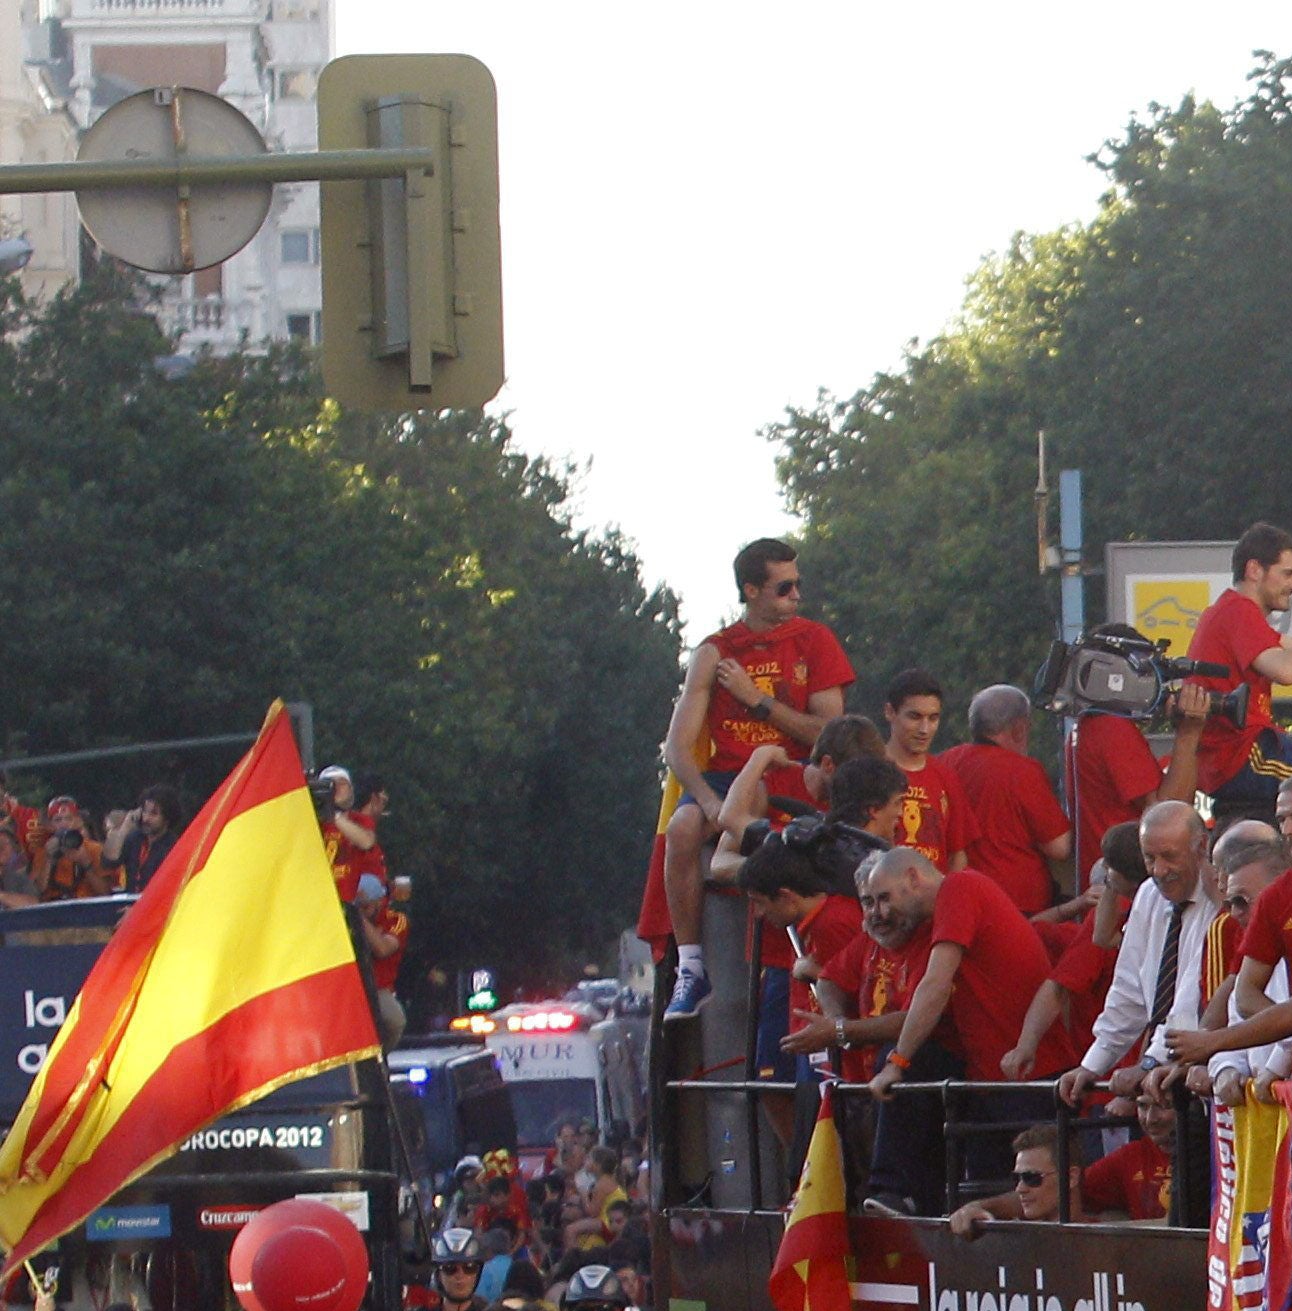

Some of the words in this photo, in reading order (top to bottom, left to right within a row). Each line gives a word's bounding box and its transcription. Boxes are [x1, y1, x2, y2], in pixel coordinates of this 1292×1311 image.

[722, 719, 778, 735] CAMPE
[25, 990, 66, 1027] la
[502, 1043, 576, 1062] MUR
[275, 1127, 323, 1148] 2012
[200, 1209, 258, 1227] Cruzcam
